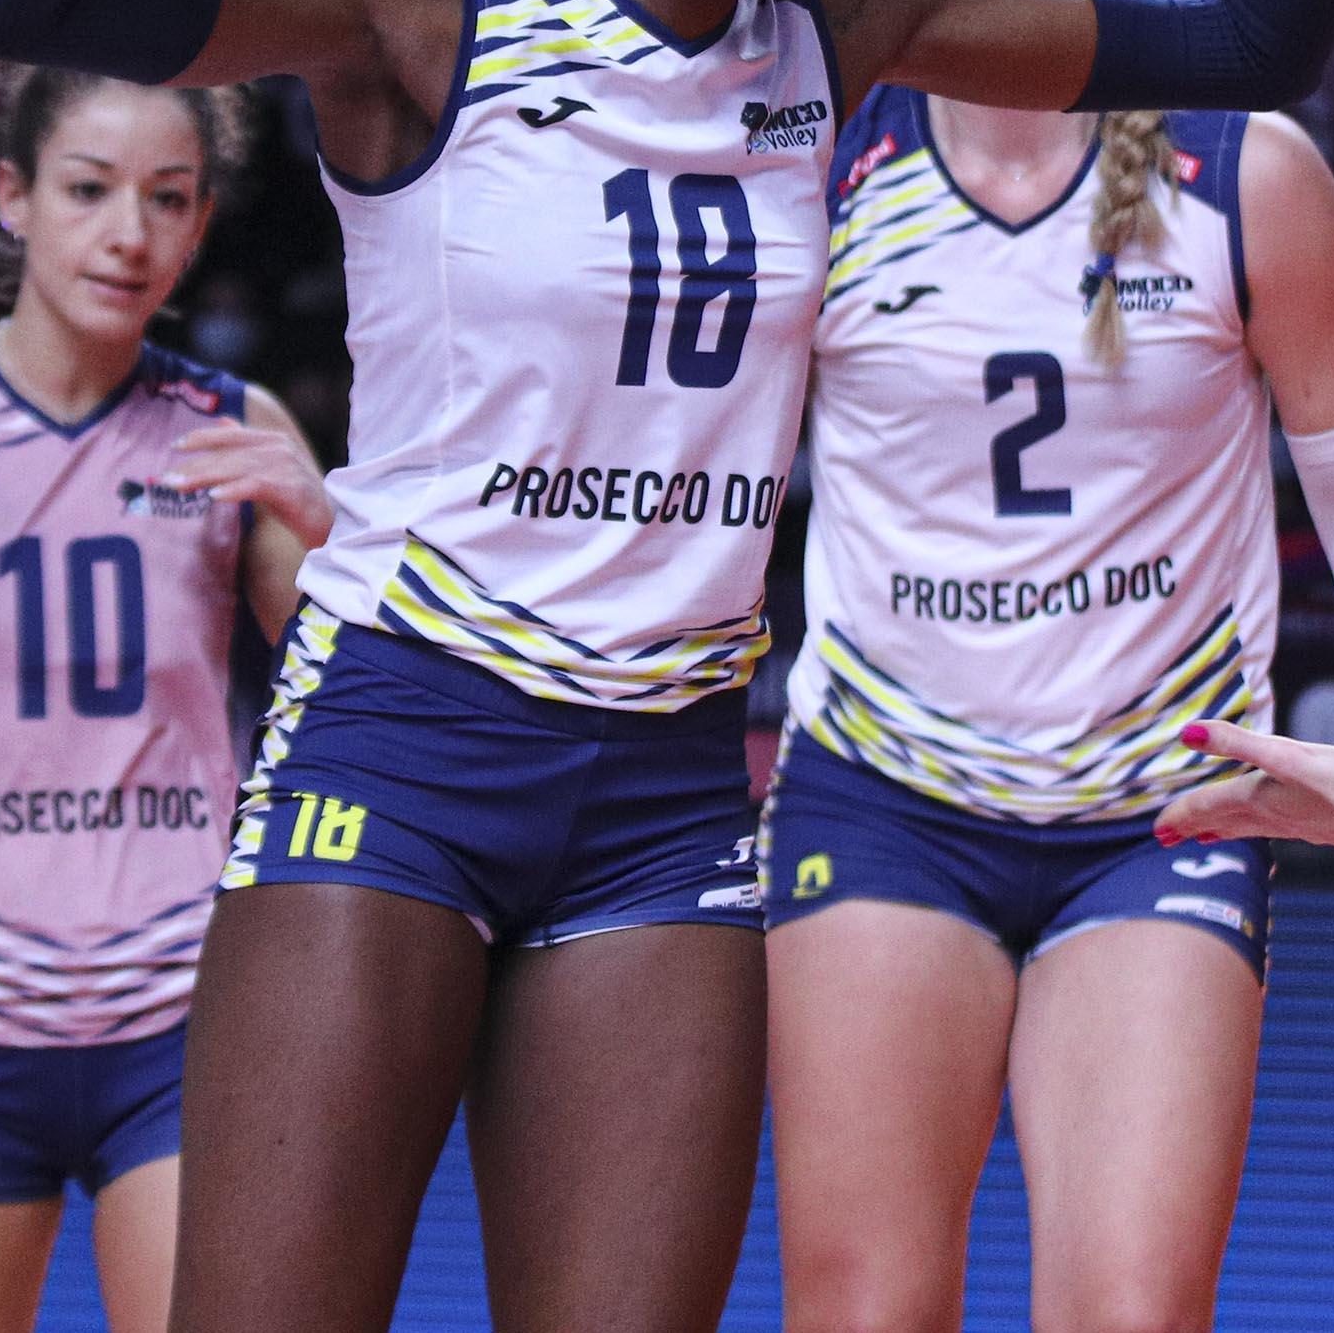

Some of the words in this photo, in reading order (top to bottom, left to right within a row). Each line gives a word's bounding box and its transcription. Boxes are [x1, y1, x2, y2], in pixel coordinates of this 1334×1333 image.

[764, 127, 817, 150] Volley
[601, 168, 758, 390] 18
[982, 351, 1072, 519] 2
[477, 463, 710, 525] PROSECCO
[890, 569, 1091, 623] PROSECCO
[1104, 554, 1176, 608] DOC
[136, 784, 208, 830] DOC
[287, 791, 366, 862] 18
